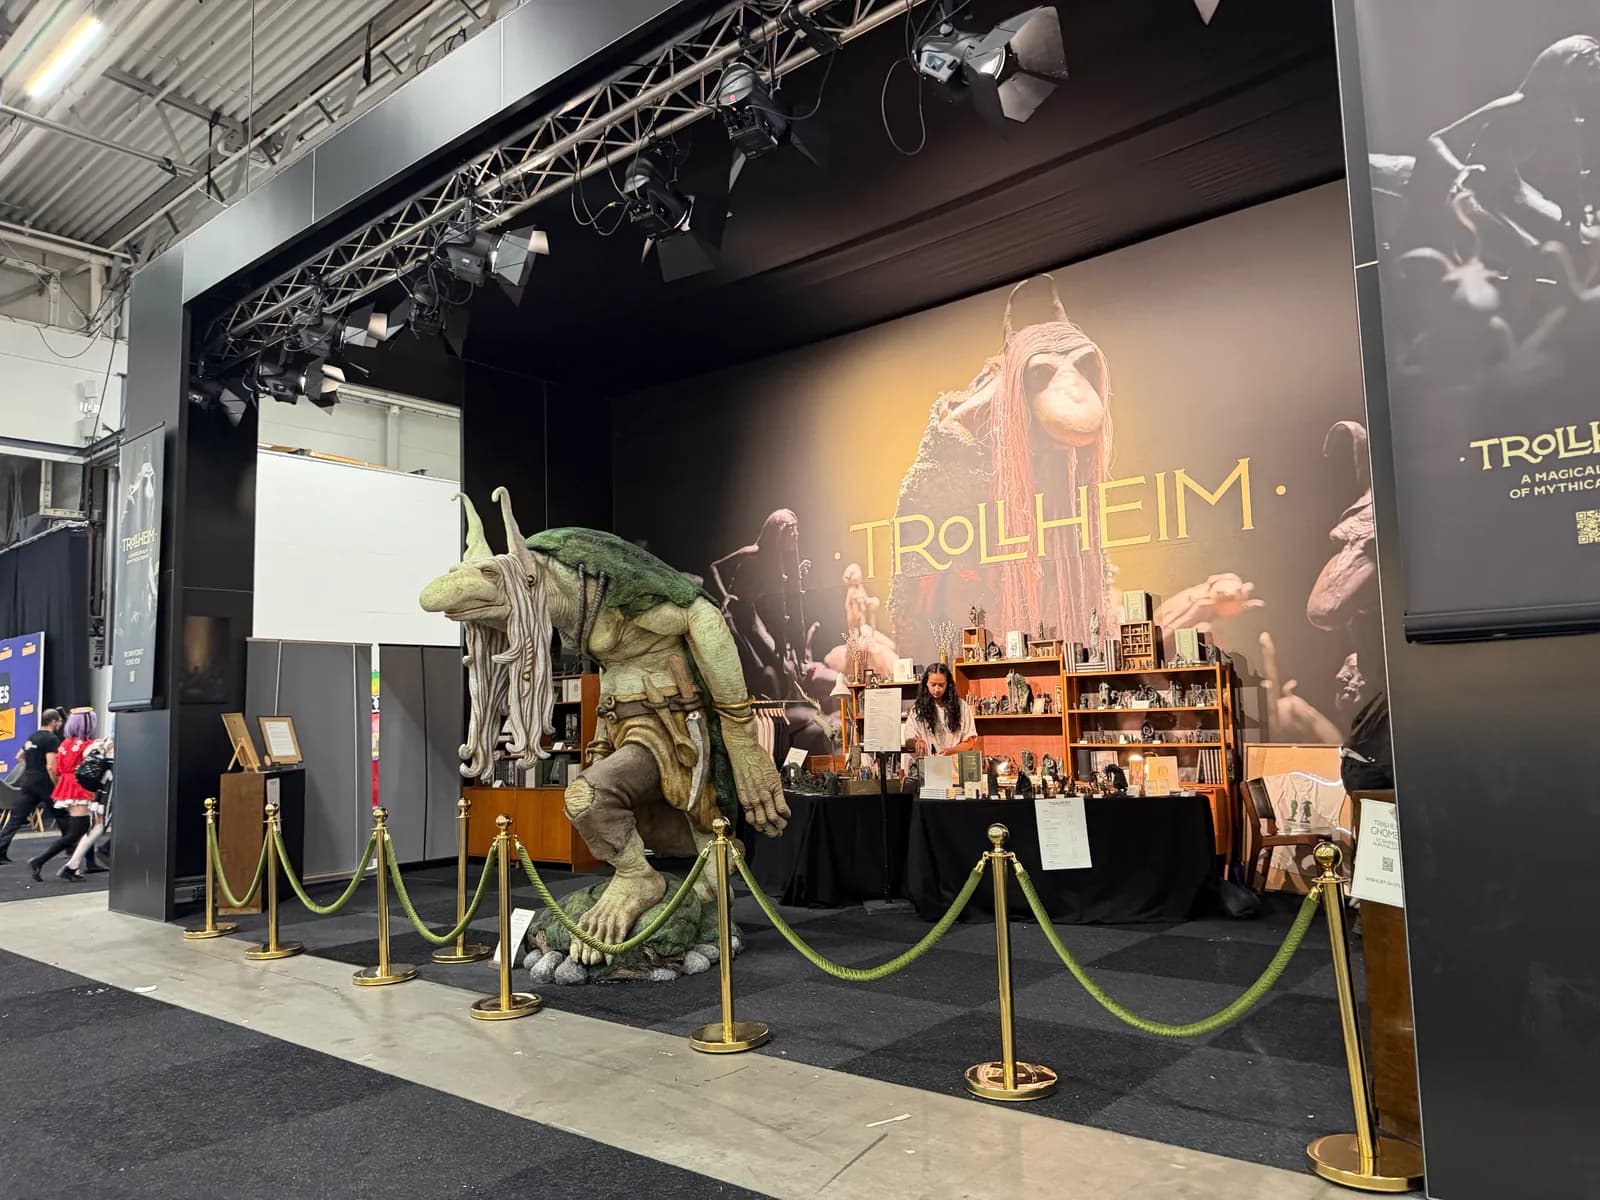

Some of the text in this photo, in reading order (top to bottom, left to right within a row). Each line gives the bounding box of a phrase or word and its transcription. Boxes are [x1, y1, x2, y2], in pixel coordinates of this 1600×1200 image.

[1520, 474, 1531, 484] A
[1509, 488, 1530, 499] OF
[849, 457, 1254, 579] TROLLHEIM
